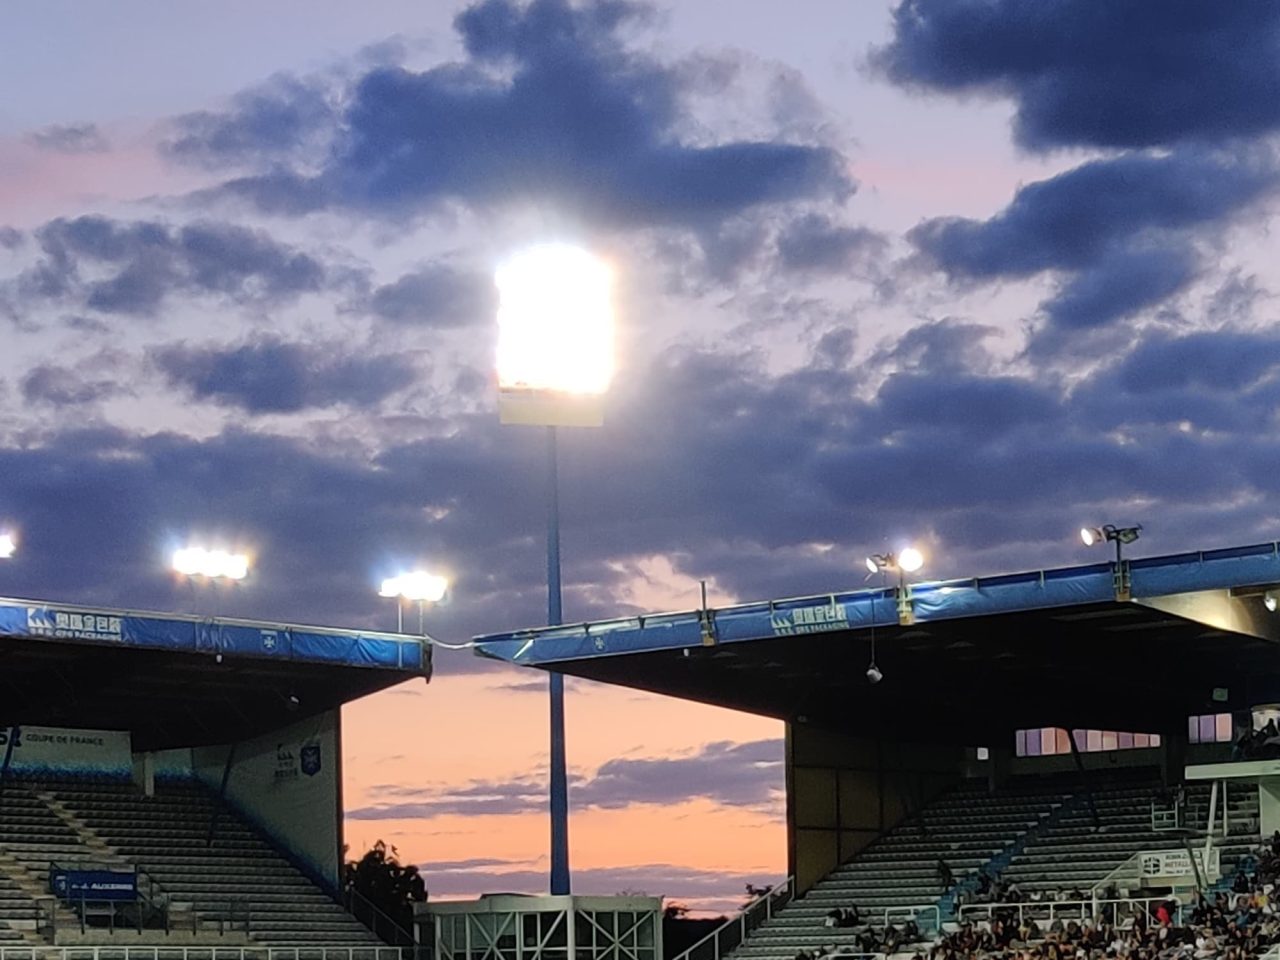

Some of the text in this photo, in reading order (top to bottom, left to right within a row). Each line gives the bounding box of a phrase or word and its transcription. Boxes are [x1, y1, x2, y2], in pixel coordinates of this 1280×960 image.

[26, 733, 104, 746] COUPE DE FRANCE
